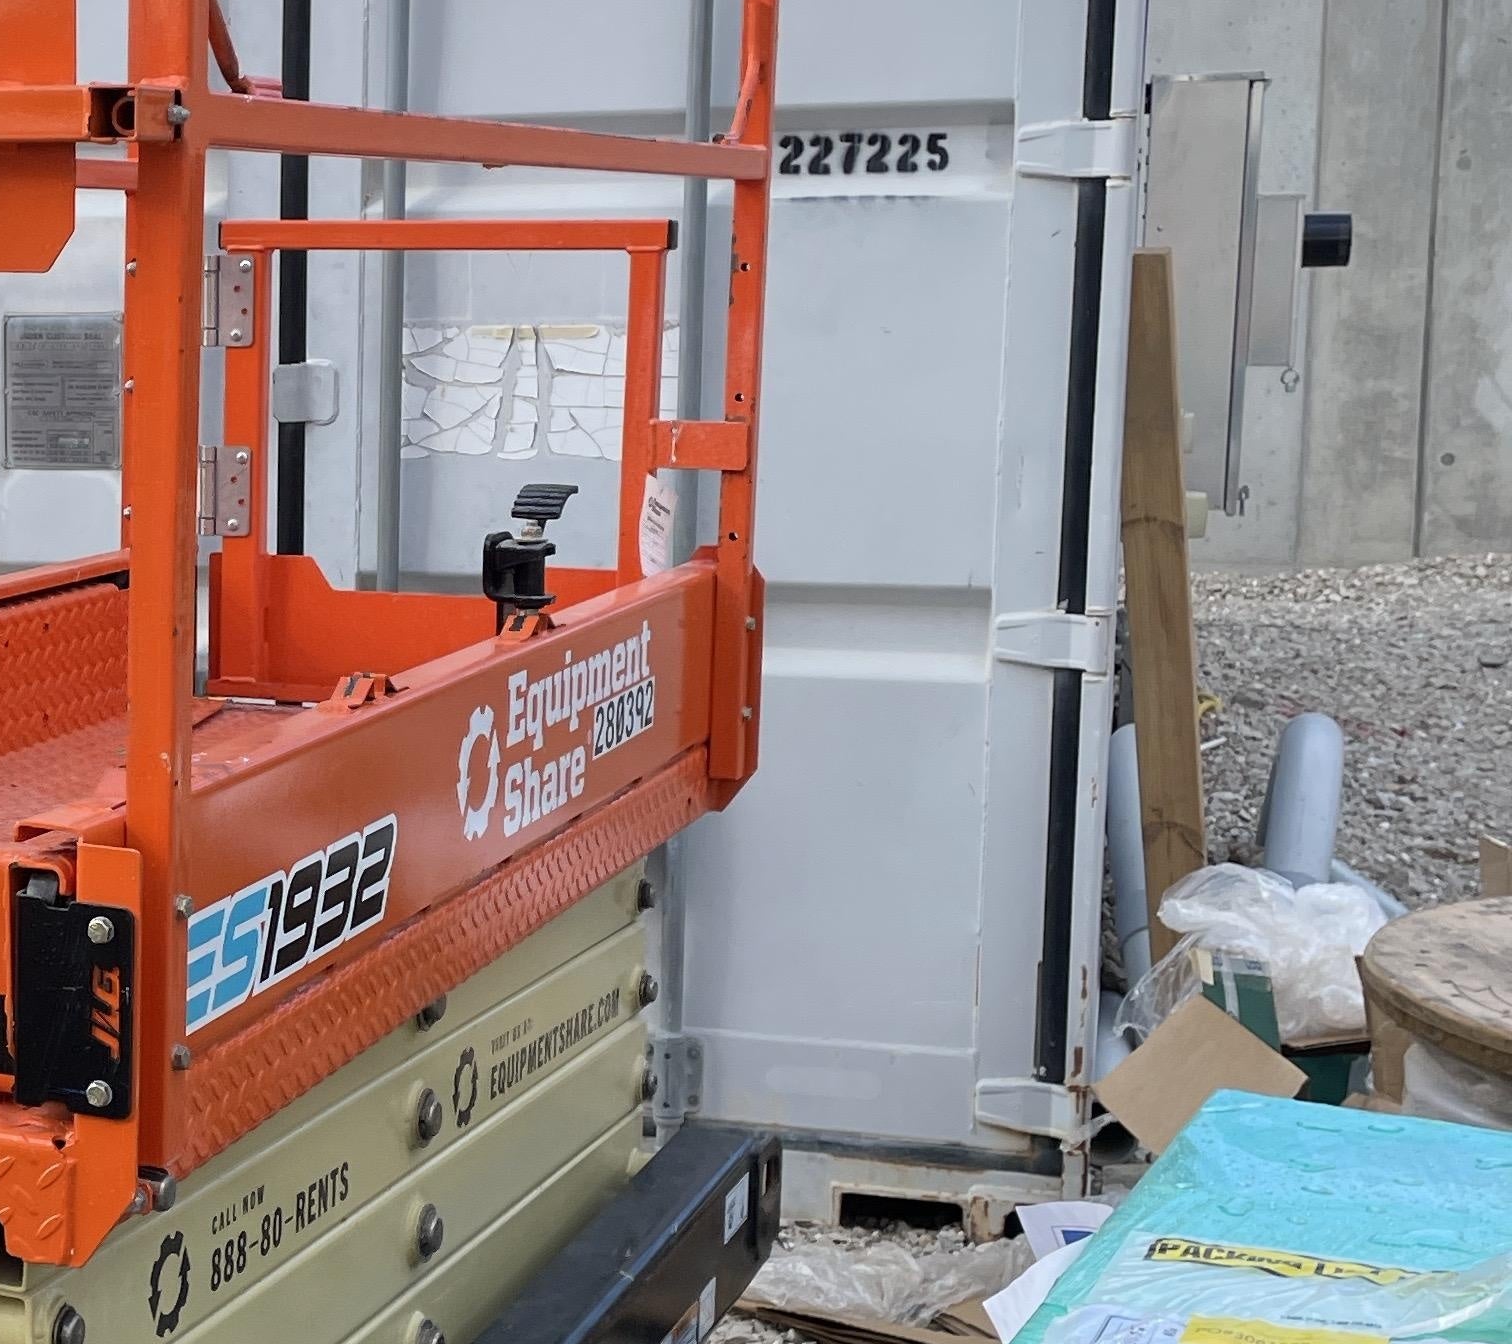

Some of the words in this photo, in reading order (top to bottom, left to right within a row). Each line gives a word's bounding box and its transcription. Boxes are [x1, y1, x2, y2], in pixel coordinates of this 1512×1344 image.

[778, 132, 950, 175] 227225
[506, 620, 654, 751] Equipment
[594, 680, 654, 757] 280392
[503, 742, 586, 838] Share
[186, 813, 397, 1035] ES1932
[92, 965, 122, 1060] JLG
[490, 987, 620, 1101] EQUIPMENTSHARE.COM
[210, 1161, 349, 1292] 888-80-RENTS
[211, 1203, 237, 1235] CALL
[242, 1184, 265, 1216] NOW
